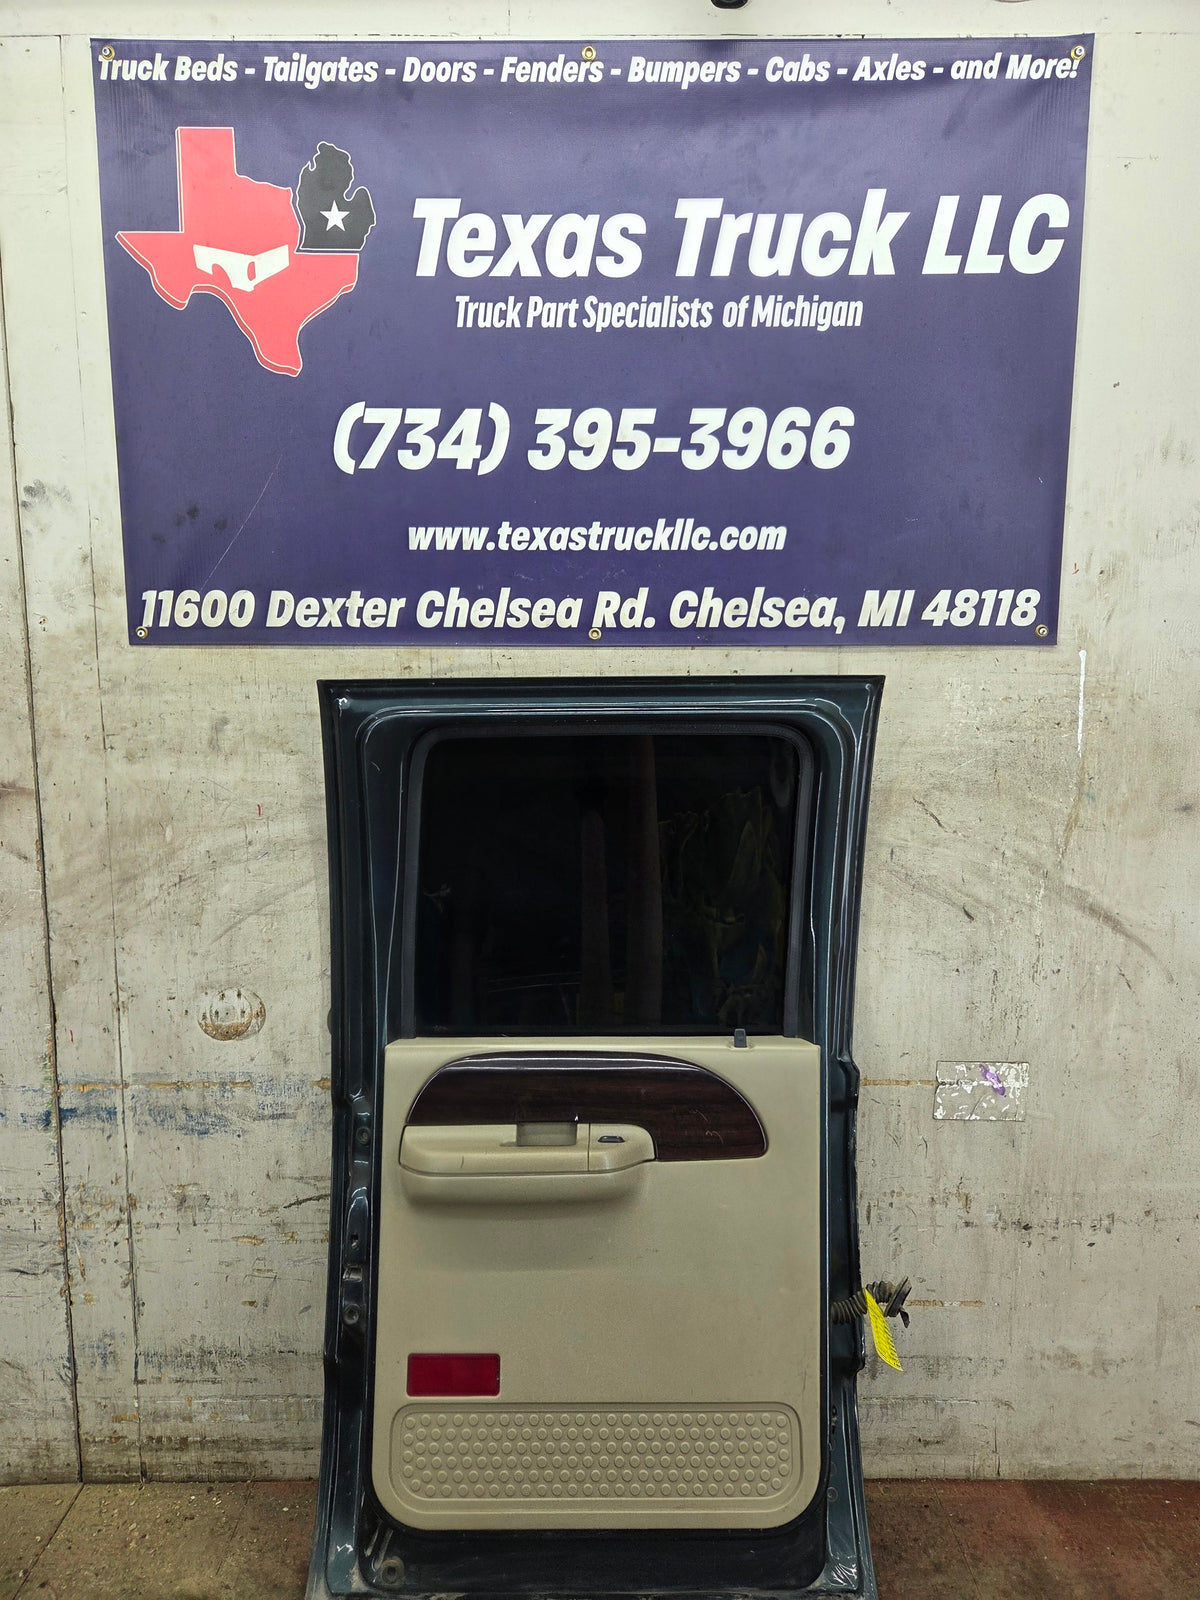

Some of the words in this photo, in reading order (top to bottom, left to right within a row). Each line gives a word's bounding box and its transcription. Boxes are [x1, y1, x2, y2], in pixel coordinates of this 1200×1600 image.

[98, 53, 169, 81] Truck
[174, 53, 239, 82] Beds
[264, 54, 378, 90] Tailgates
[403, 57, 478, 83] Doors
[501, 54, 605, 83] Fenders
[628, 56, 741, 90] Bumpers
[765, 54, 831, 83] Cabs
[852, 53, 927, 82] Axles
[951, 52, 1003, 80] and
[1005, 53, 1081, 80] More!
[413, 197, 647, 279] Texas
[674, 188, 911, 278] Truck
[921, 193, 1070, 276] LLC
[456, 295, 524, 329] Truck
[526, 295, 579, 329] Part
[582, 295, 714, 333] Specialists
[722, 294, 750, 328] of
[751, 294, 864, 332] Michigan
[333, 401, 511, 476] (734)
[527, 407, 855, 471] 395-3966
[408, 518, 788, 551] www.texastruckllc.com
[140, 590, 256, 628] 11600
[266, 590, 407, 628] Dexter
[416, 587, 584, 629] Chelsea
[591, 587, 656, 629] Rd.
[669, 586, 846, 635] Chelsea,
[857, 589, 915, 628] MI
[920, 588, 1041, 627] 48118
